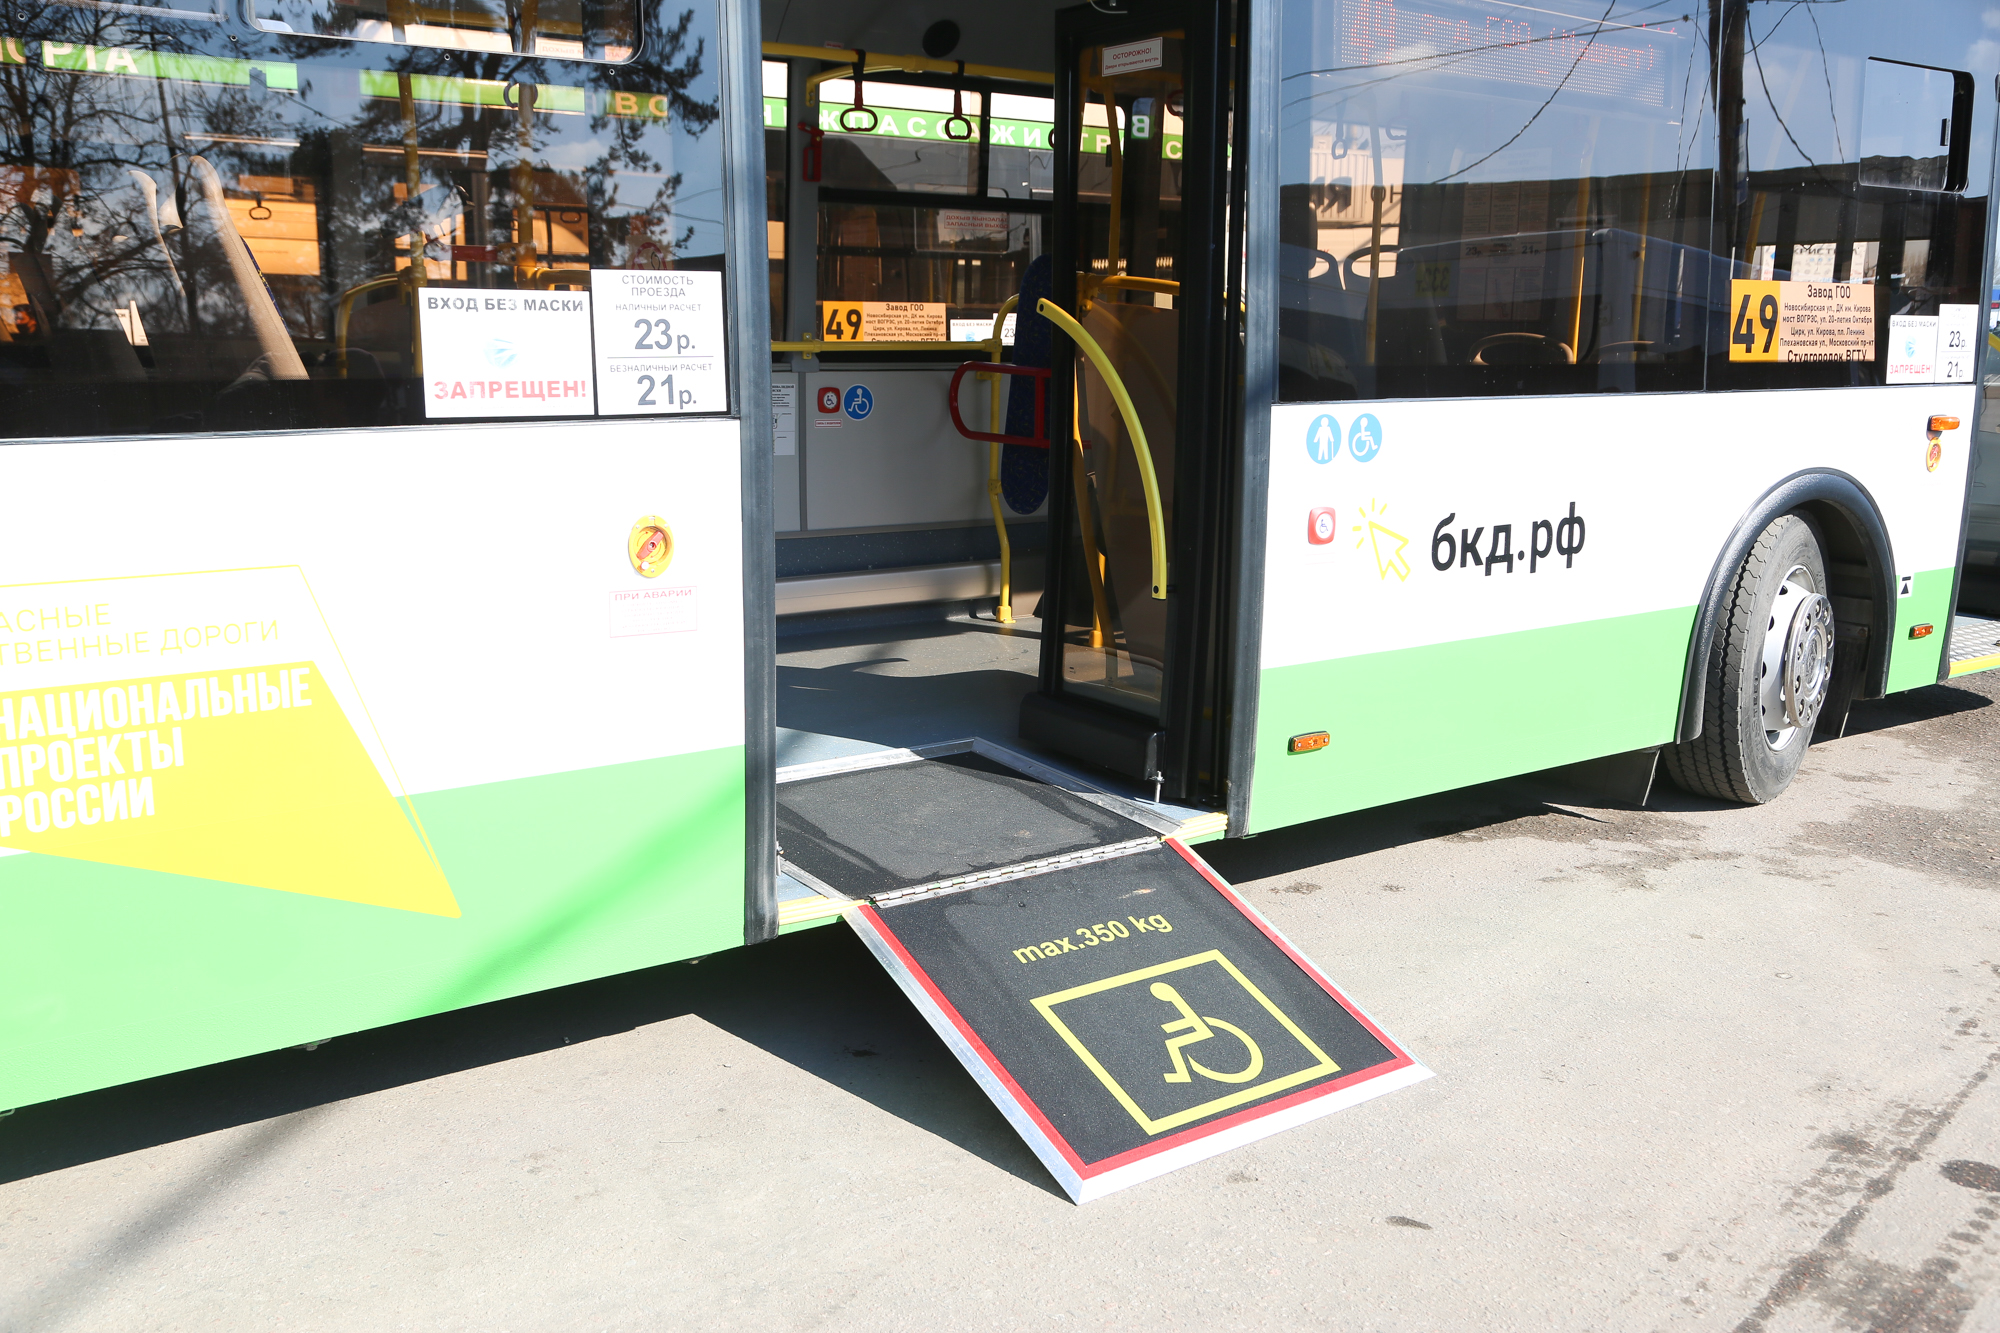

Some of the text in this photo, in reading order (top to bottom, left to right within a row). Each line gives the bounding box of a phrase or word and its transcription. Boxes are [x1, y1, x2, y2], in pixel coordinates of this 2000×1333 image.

[1350, 0, 1396, 66] 49
[1112, 47, 1152, 60] ОСТОРОЖНО!
[621, 275, 694, 286] СТОИМОСТЬ
[631, 287, 686, 298] ПРОЕЗДА
[1807, 284, 1850, 300] Завод ГОО
[427, 297, 583, 312] ВХОД БЕЗ МАСКИ
[669, 303, 702, 312] РАСЧЕТ
[885, 303, 924, 312] Завод ГОО
[1784, 303, 1825, 313] Новосибирская
[1836, 304, 1844, 313] ДК
[1853, 305, 1872, 313] Кирова
[825, 308, 862, 340] 49
[1732, 294, 1778, 353] 49
[1796, 315, 1819, 324] ВОГРЭС,
[1828, 315, 1852, 324] 20-летия
[1852, 316, 1873, 325] Октября
[1892, 320, 1937, 328] ВХОД БЕЗ МАСКИ
[1790, 327, 1806, 336] Цирк,
[1816, 327, 1836, 336] Кирова,
[1846, 327, 1865, 336] Ленина
[1780, 338, 1818, 347] Плехановская
[1829, 337, 1860, 347] Московский
[680, 363, 712, 371] РАСЧЕТ
[433, 380, 587, 401] ЗАПРЕЩЕН!
[1431, 501, 1586, 577] бкд.рф
[614, 589, 692, 601] ПРИ АВАРИИ
[160, 620, 278, 656] ДОРОГИ
[0, 667, 313, 741] НАЦИОНАЛЬНЫЕ
[0, 726, 185, 790] ПРОЕКТЫ
[0, 776, 155, 838] РОССИИ
[1128, 914, 1173, 933] kg
